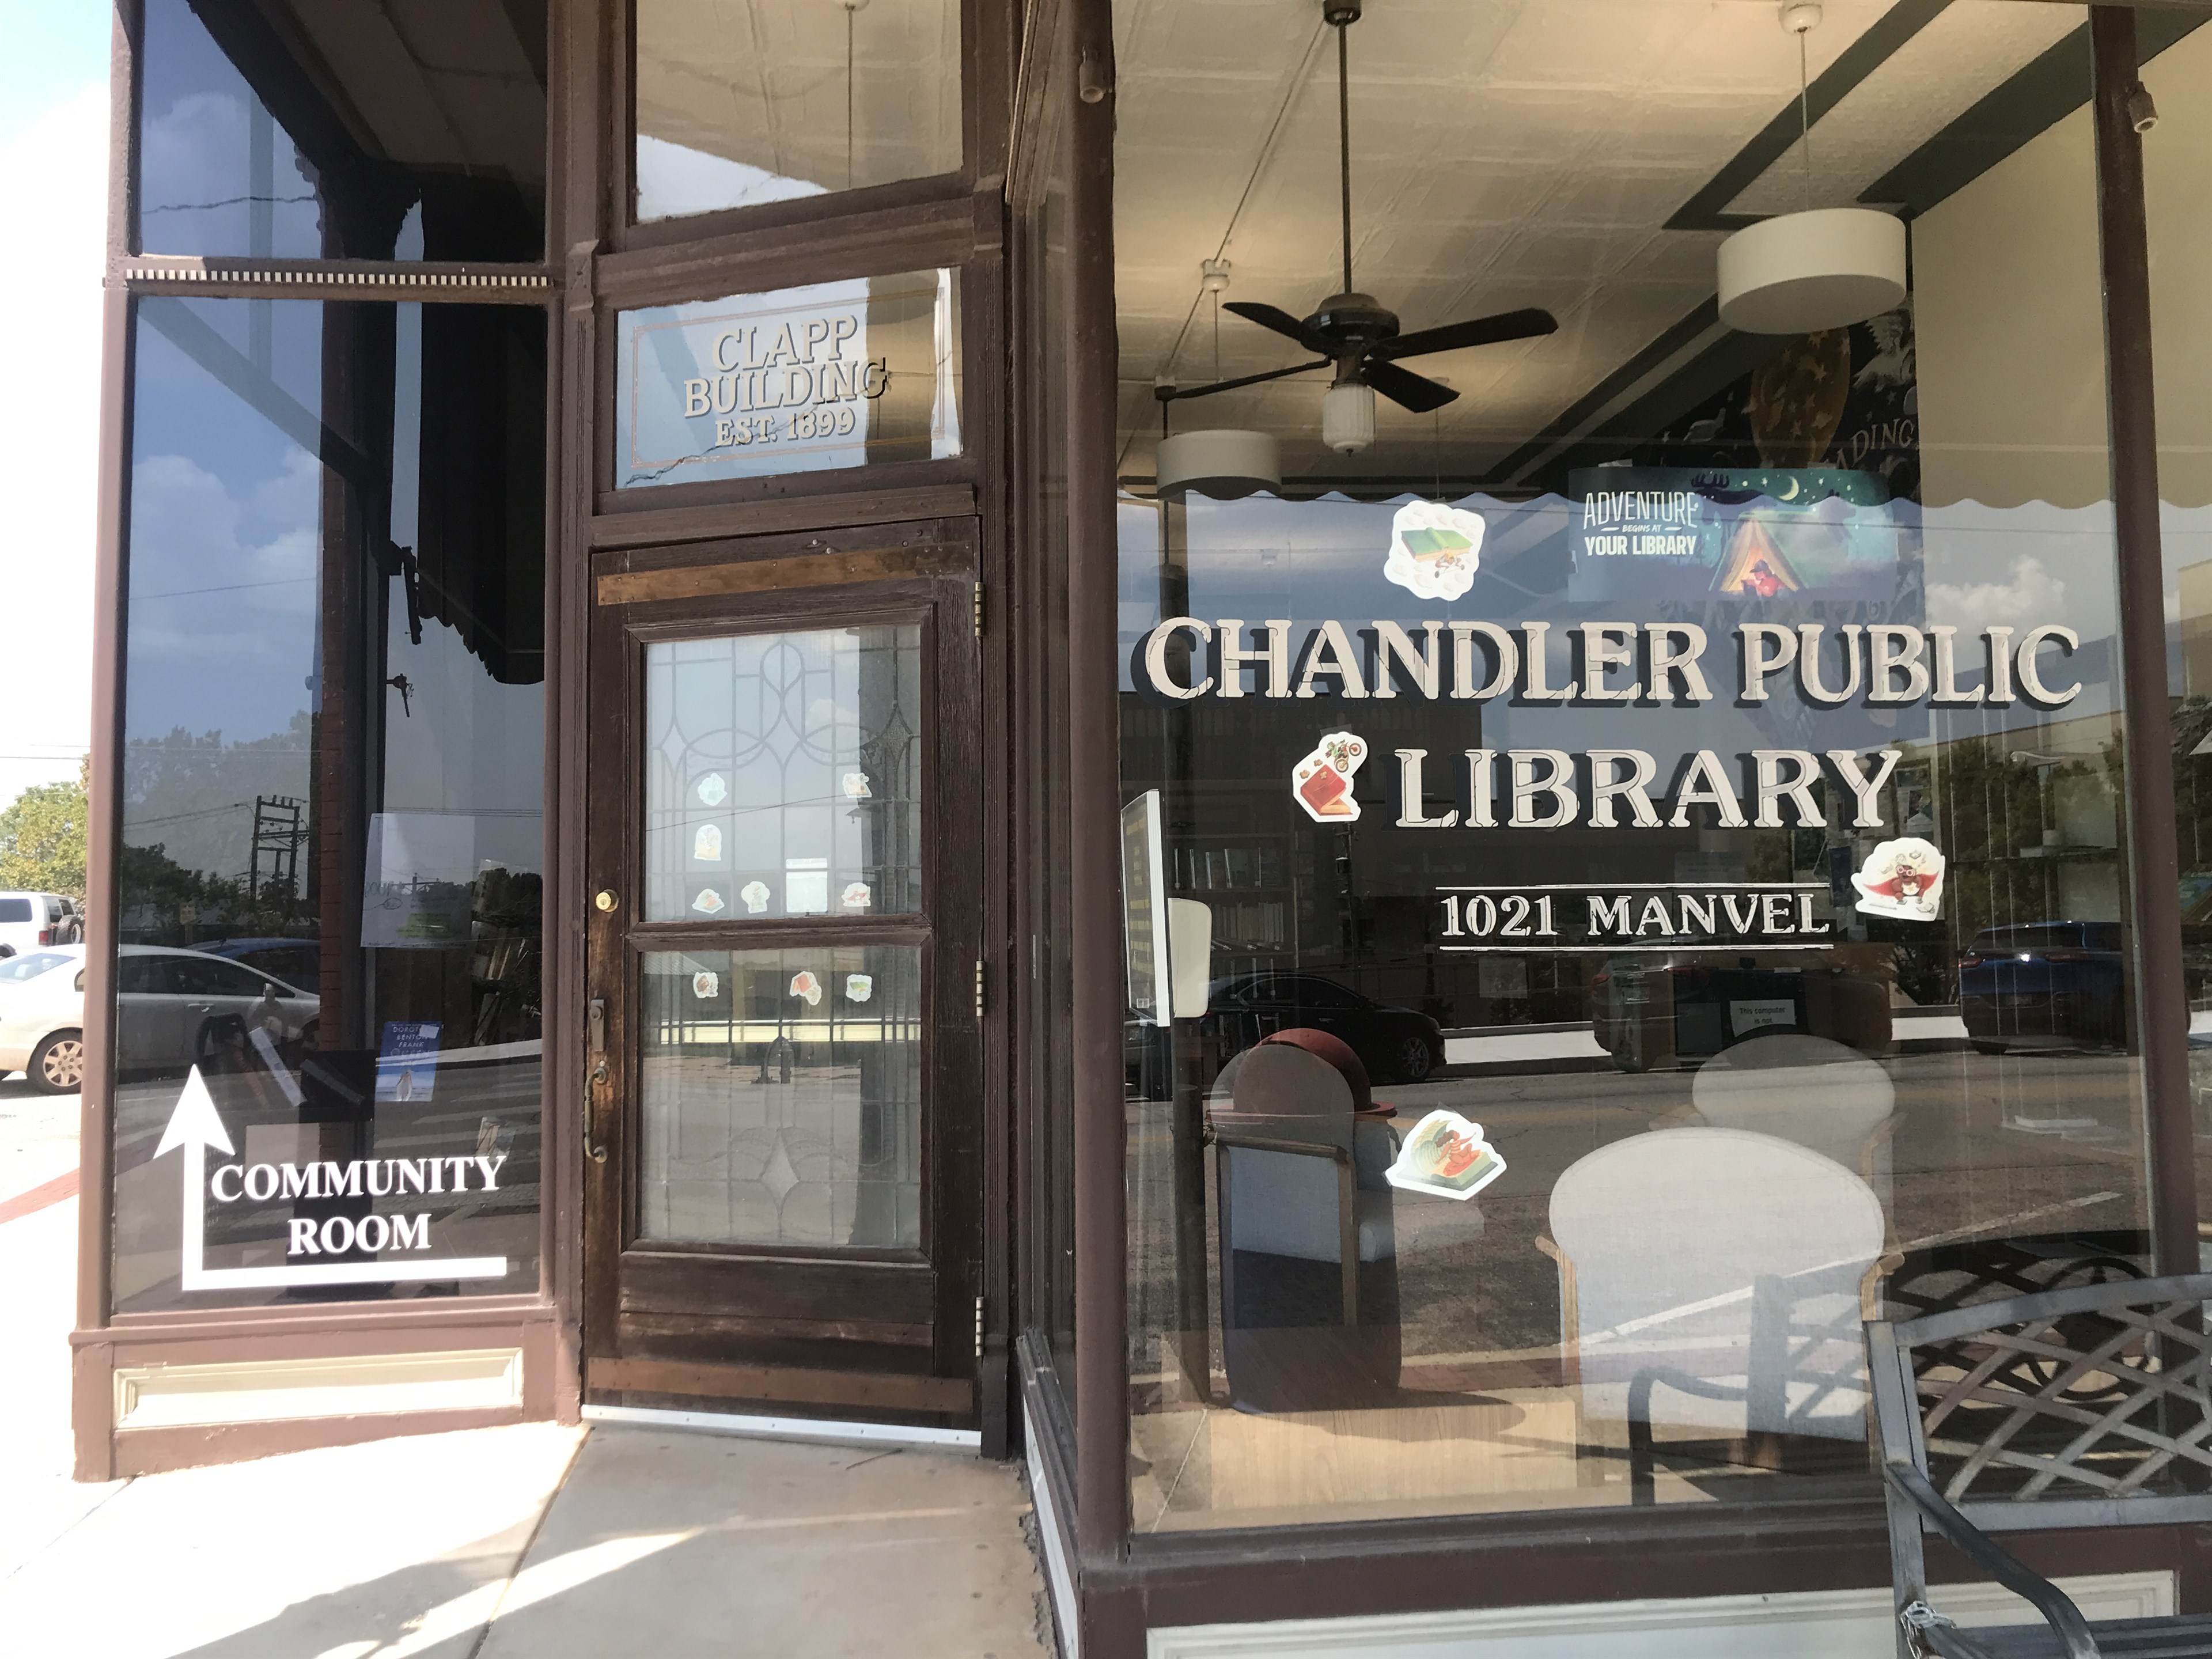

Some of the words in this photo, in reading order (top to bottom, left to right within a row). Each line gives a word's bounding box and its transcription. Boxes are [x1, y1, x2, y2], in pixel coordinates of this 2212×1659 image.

[712, 315, 858, 373] CLAPP
[684, 357, 888, 418] BUILDING
[715, 415, 778, 447] EST.
[787, 406, 856, 441] 1899
[1583, 491, 1699, 531] ADVENTURE
[1622, 524, 1651, 533] BEGINS
[1652, 524, 1662, 533] AT
[1584, 536, 1628, 556] YOUR
[1633, 535, 1698, 555] LIBRARY
[1144, 615, 1714, 701] CHANDLER
[1738, 623, 2083, 706] PUBLIC
[1393, 748, 1903, 829] LIBRARY
[1440, 893, 1559, 937] 1021
[1585, 893, 1830, 937] MANVEL
[211, 1155, 507, 1202] COMMUNITY
[286, 1213, 433, 1256] ROOM
